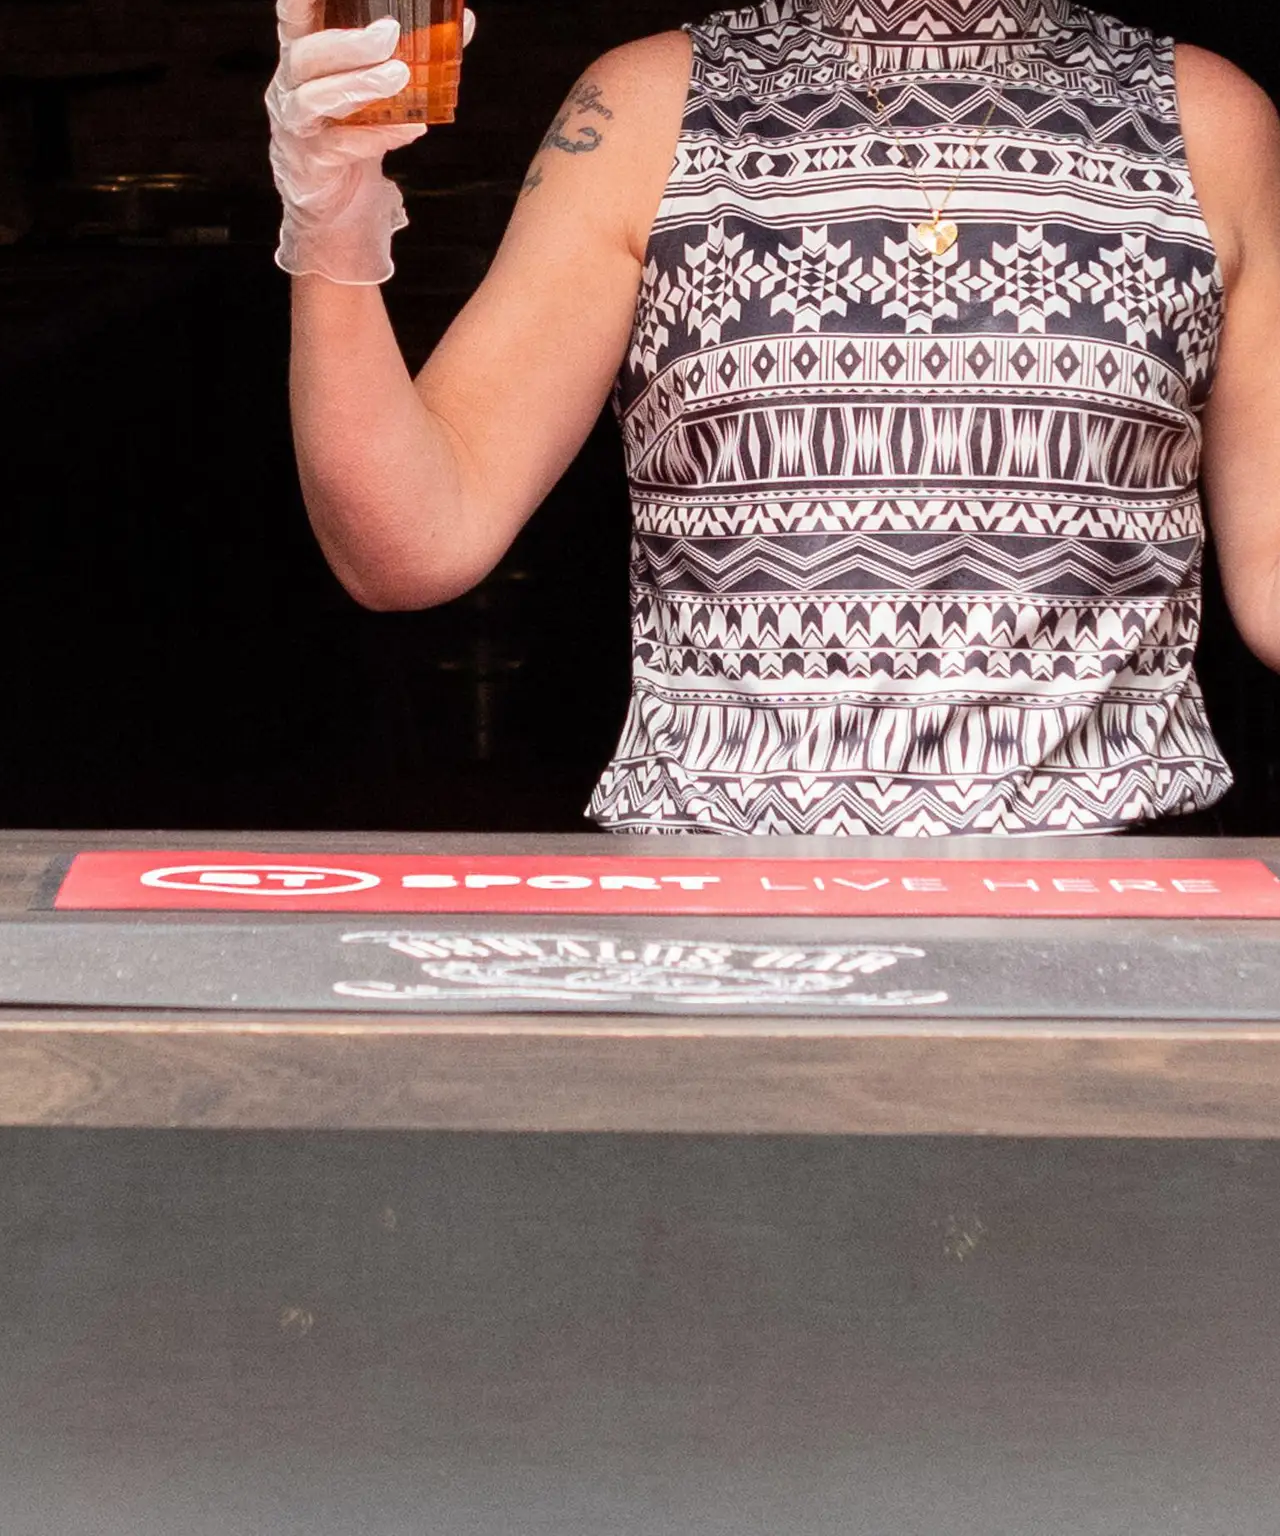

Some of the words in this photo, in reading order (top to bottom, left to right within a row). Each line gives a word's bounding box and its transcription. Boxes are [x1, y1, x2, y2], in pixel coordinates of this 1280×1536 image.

[401, 872, 719, 891] SPORT
[754, 875, 943, 893] LIVE
[978, 876, 1217, 894] HERE
